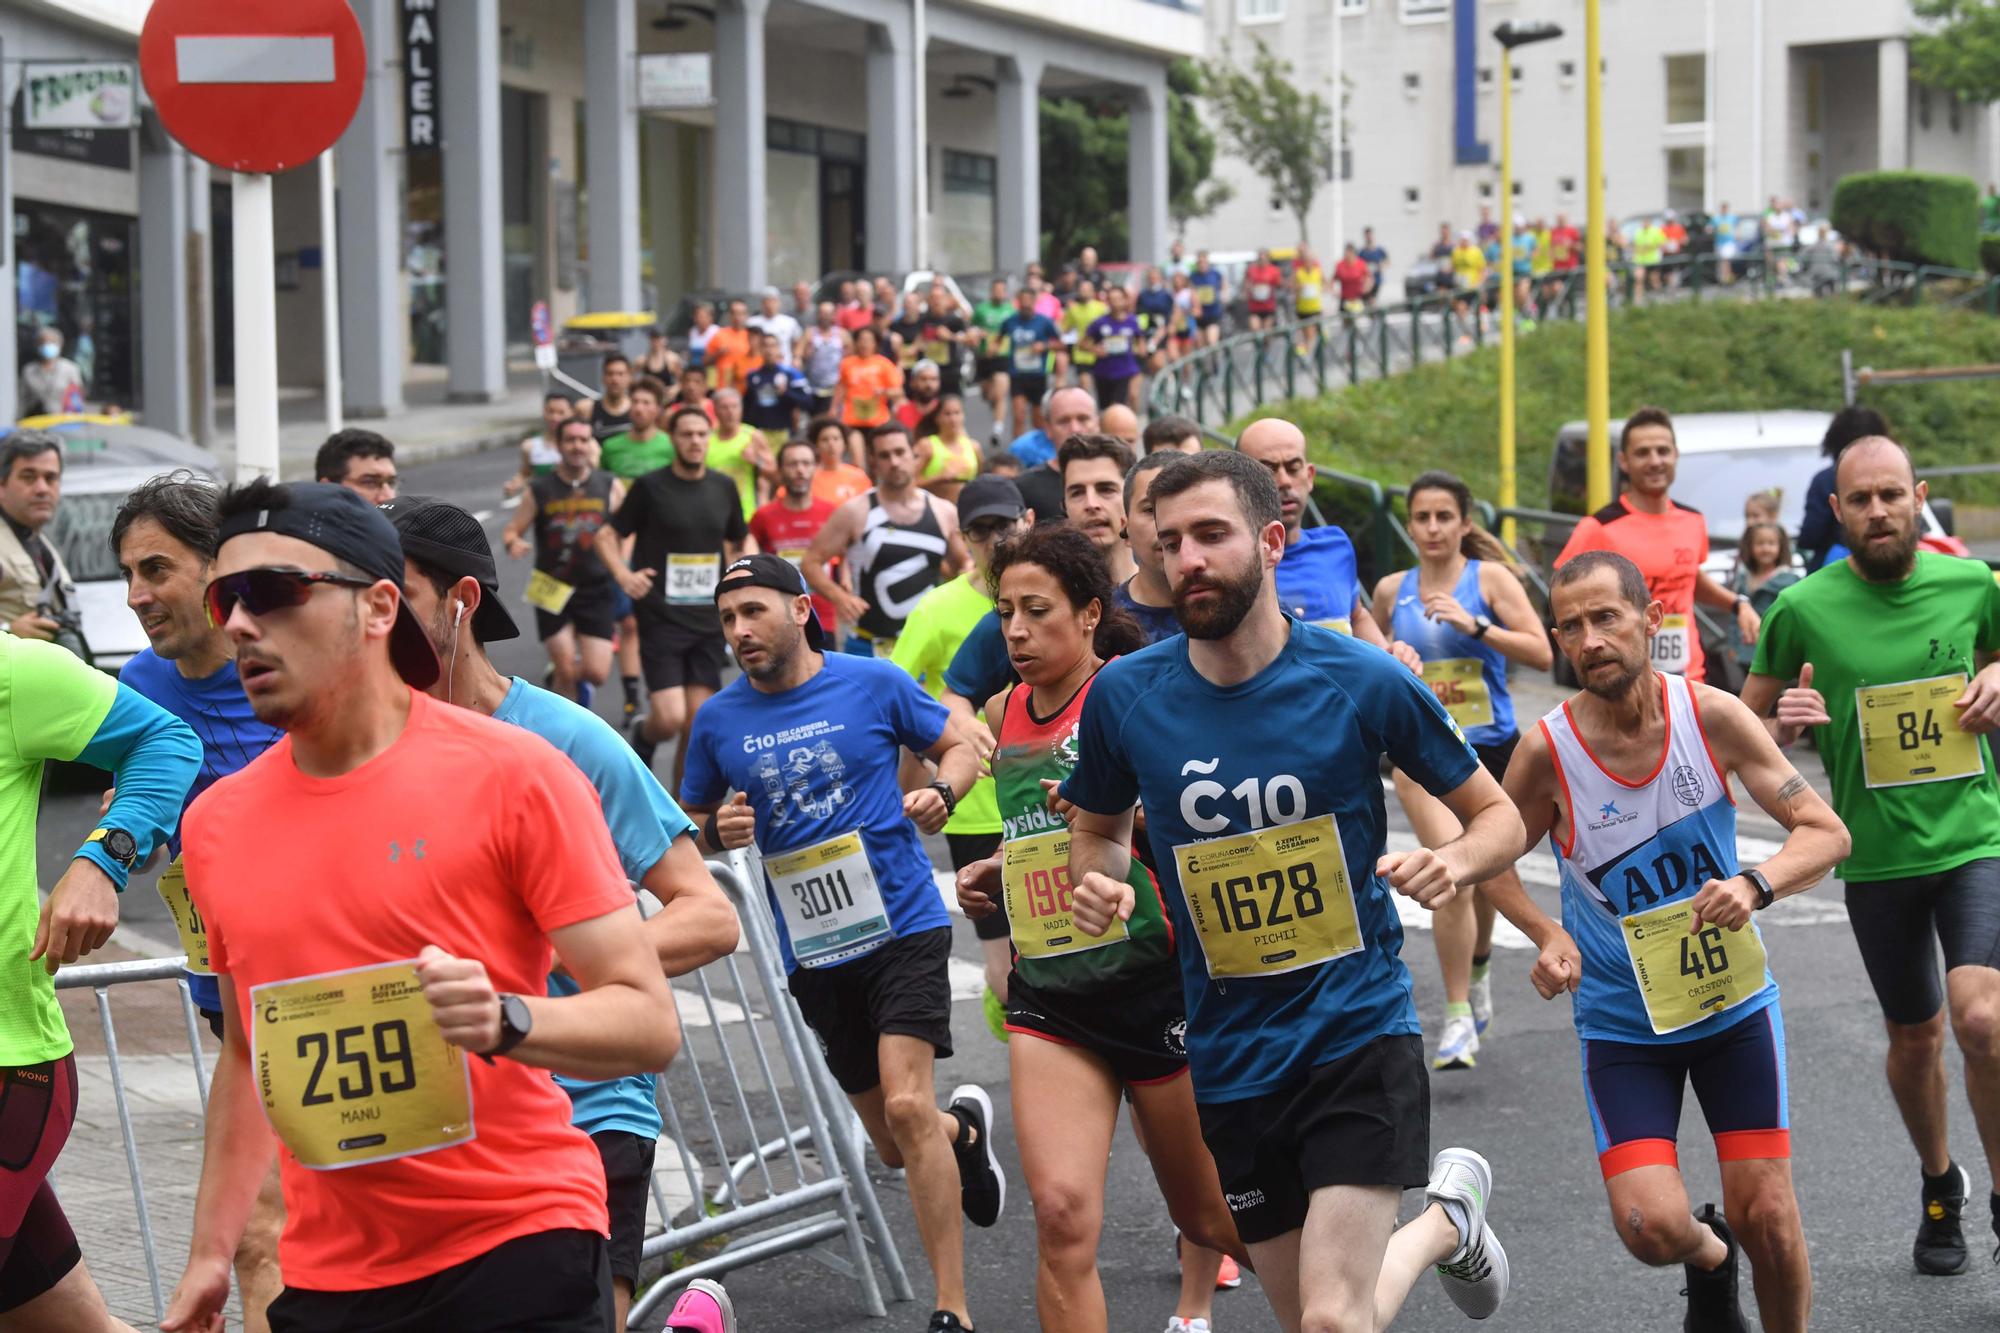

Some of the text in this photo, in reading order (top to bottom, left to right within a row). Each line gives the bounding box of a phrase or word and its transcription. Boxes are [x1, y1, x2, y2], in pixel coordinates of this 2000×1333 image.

[1897, 708, 1943, 751] 84
[1277, 843, 1291, 851] DOS
[1291, 836, 1320, 848] BARRIOS
[791, 869, 854, 920] 3011
[1211, 862, 1324, 934] 1628
[1190, 894, 1205, 925] TANDA
[1044, 918, 1071, 930] NADIA
[1253, 928, 1298, 946] PICHII
[1680, 927, 1729, 980] 46
[1636, 957, 1650, 986] TANDA
[372, 985, 423, 999] DOS BARRIO
[379, 981, 407, 991] XENTE
[1687, 975, 1733, 998] CRISTOVO
[16, 1069, 49, 1083] WONG
[259, 1051, 272, 1097] TANDA
[296, 1019, 417, 1107] 259
[340, 1106, 381, 1124] MANU
